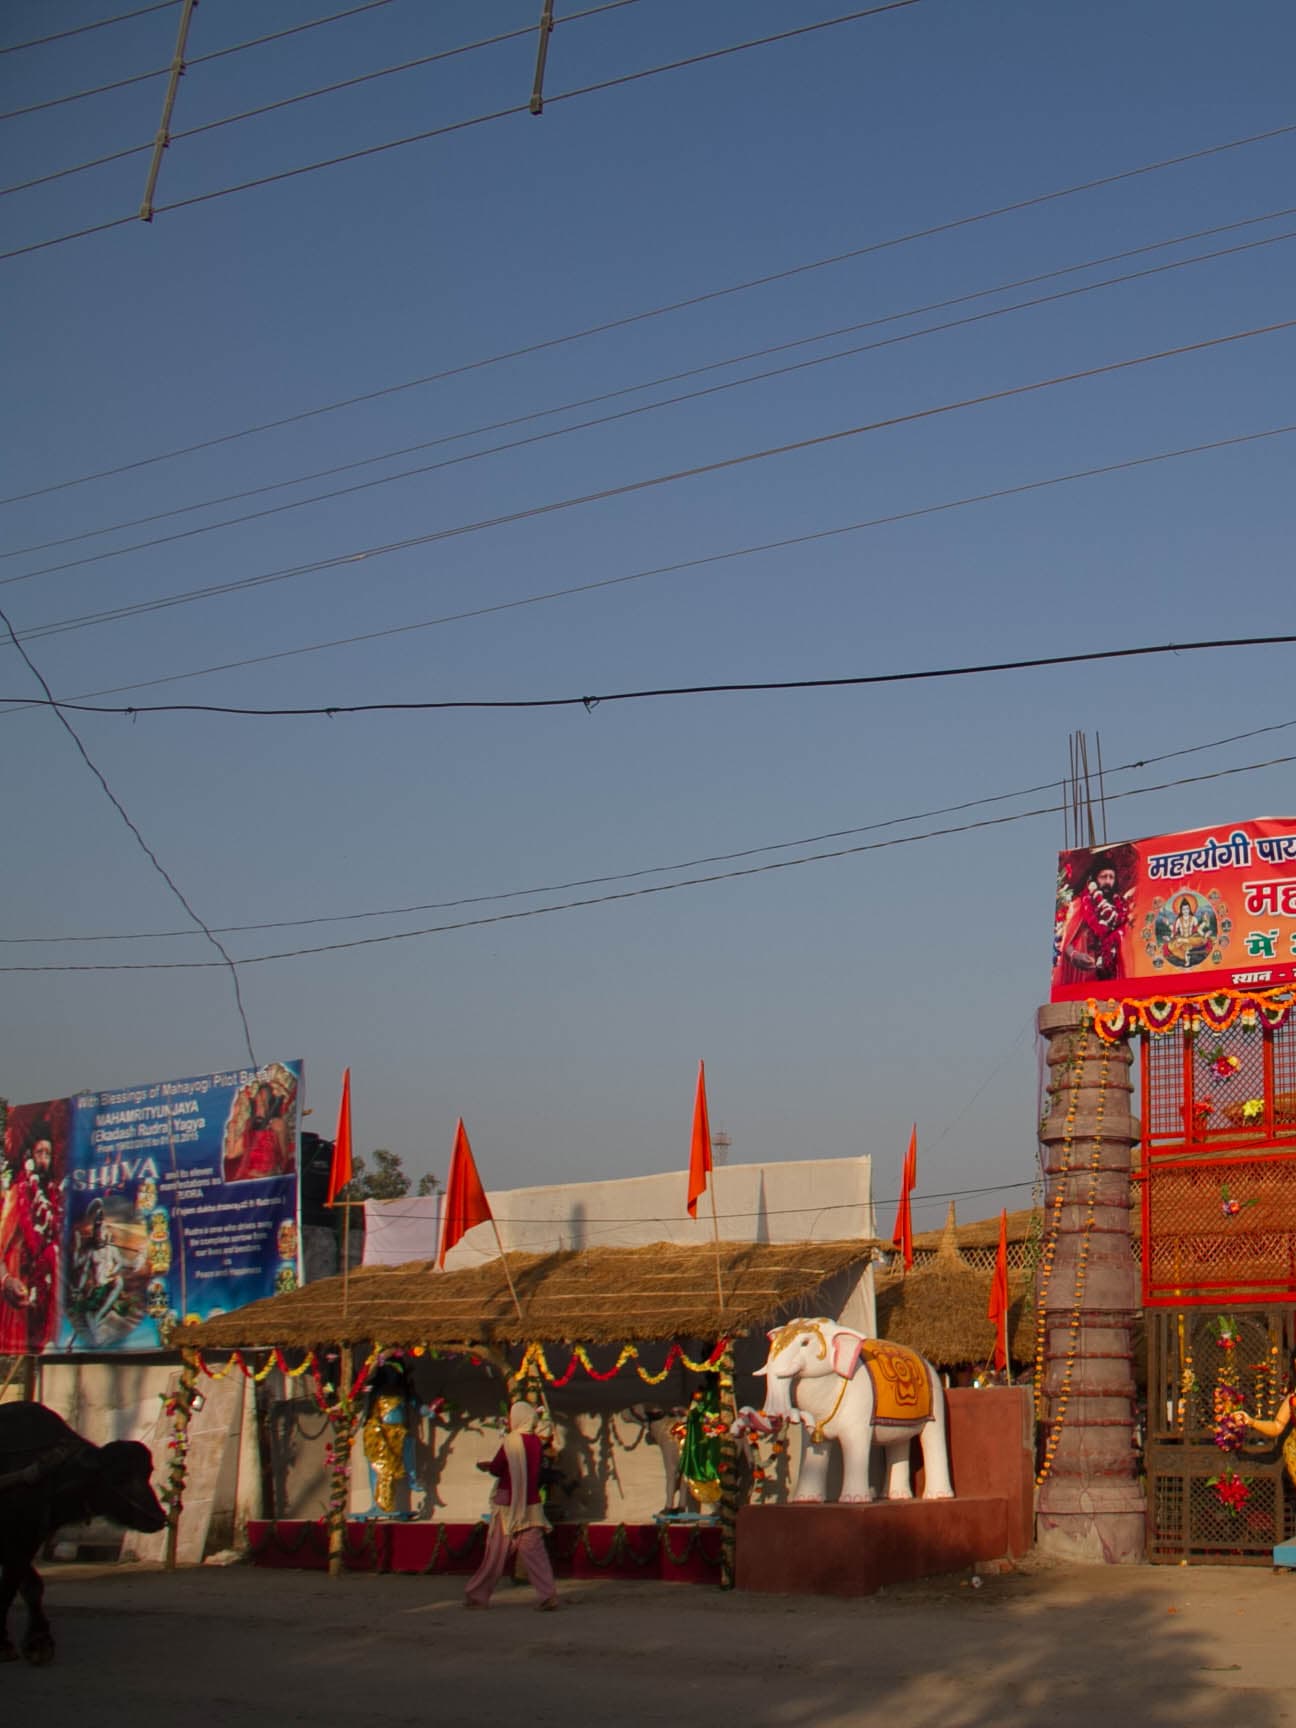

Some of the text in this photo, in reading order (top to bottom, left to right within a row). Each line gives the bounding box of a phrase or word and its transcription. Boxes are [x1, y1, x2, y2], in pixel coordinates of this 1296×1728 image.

[1149, 830, 1250, 879] महायोगी
[1245, 929, 1279, 958] में
[161, 1077, 212, 1096] Mahayogi
[72, 1157, 159, 1191] SHIVA
